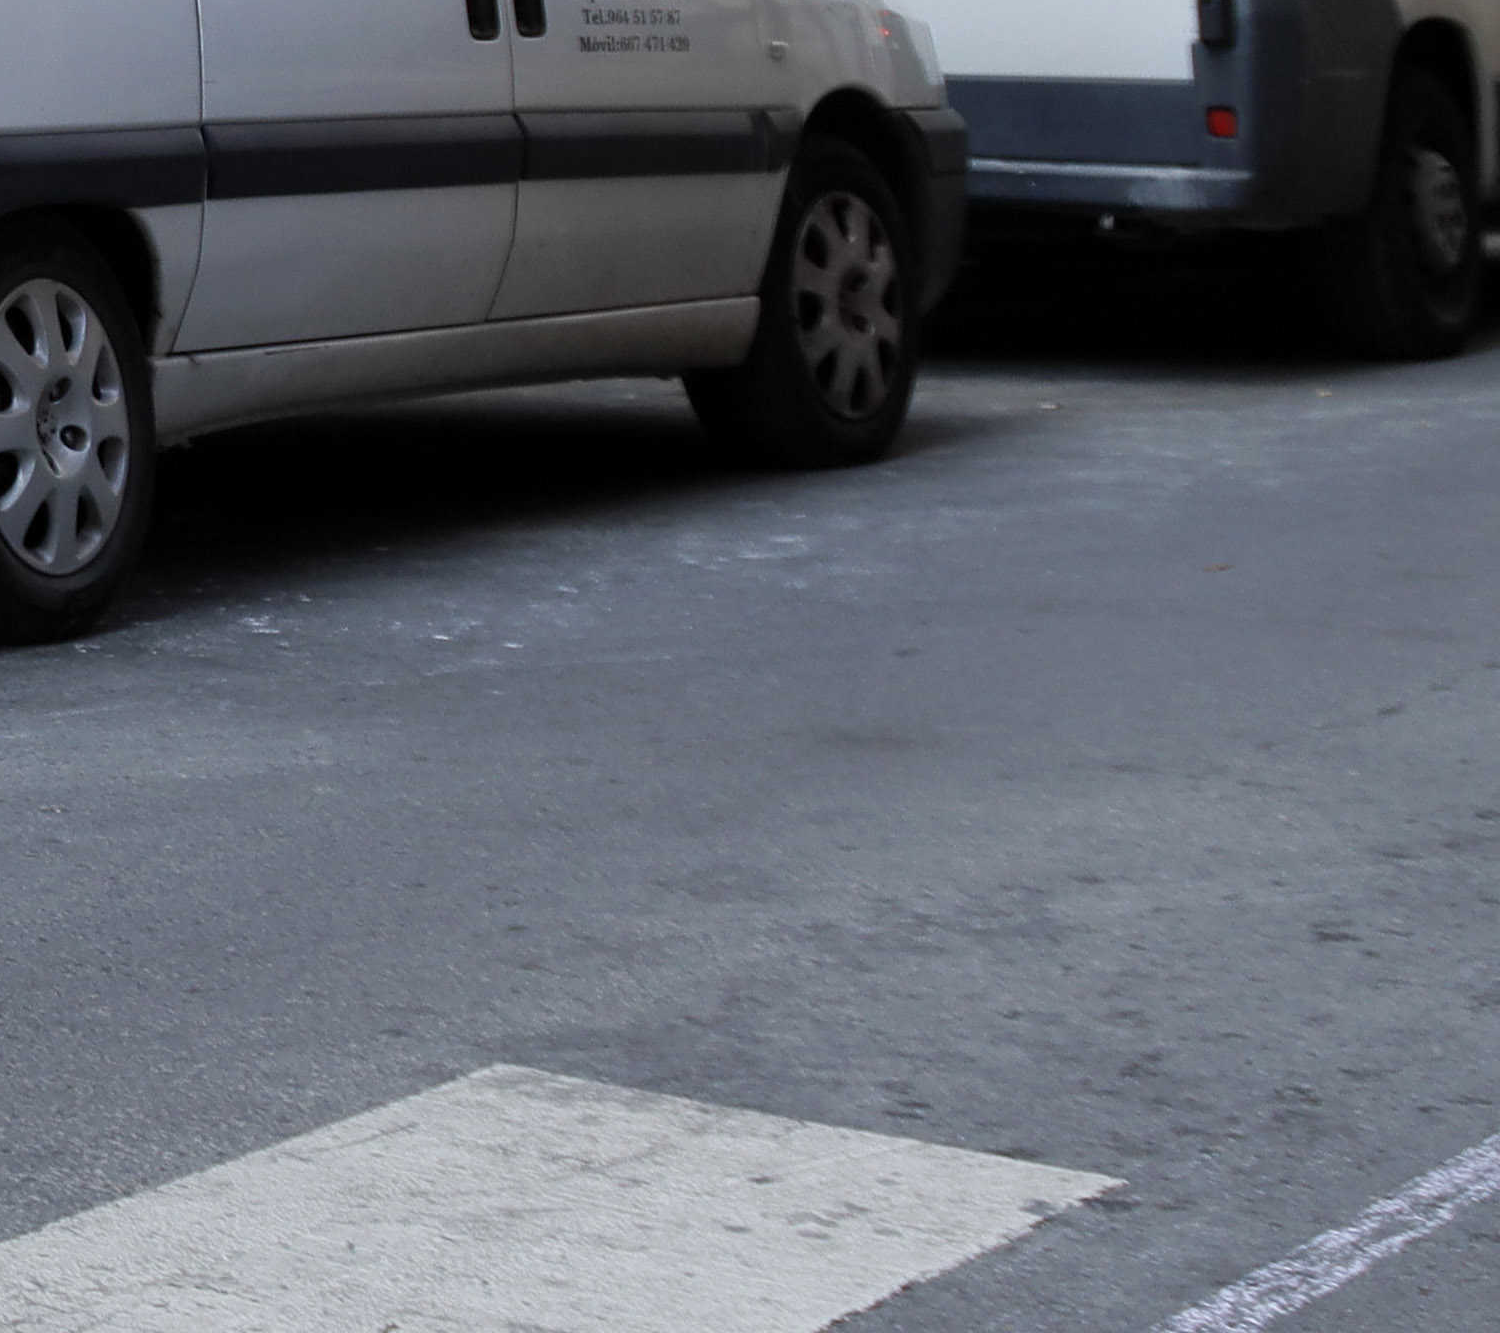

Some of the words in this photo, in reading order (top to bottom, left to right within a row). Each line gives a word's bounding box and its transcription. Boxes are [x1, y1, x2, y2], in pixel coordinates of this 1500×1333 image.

[633, 10, 646, 25] 51
[651, 10, 663, 25] 57
[666, 10, 681, 25] 87
